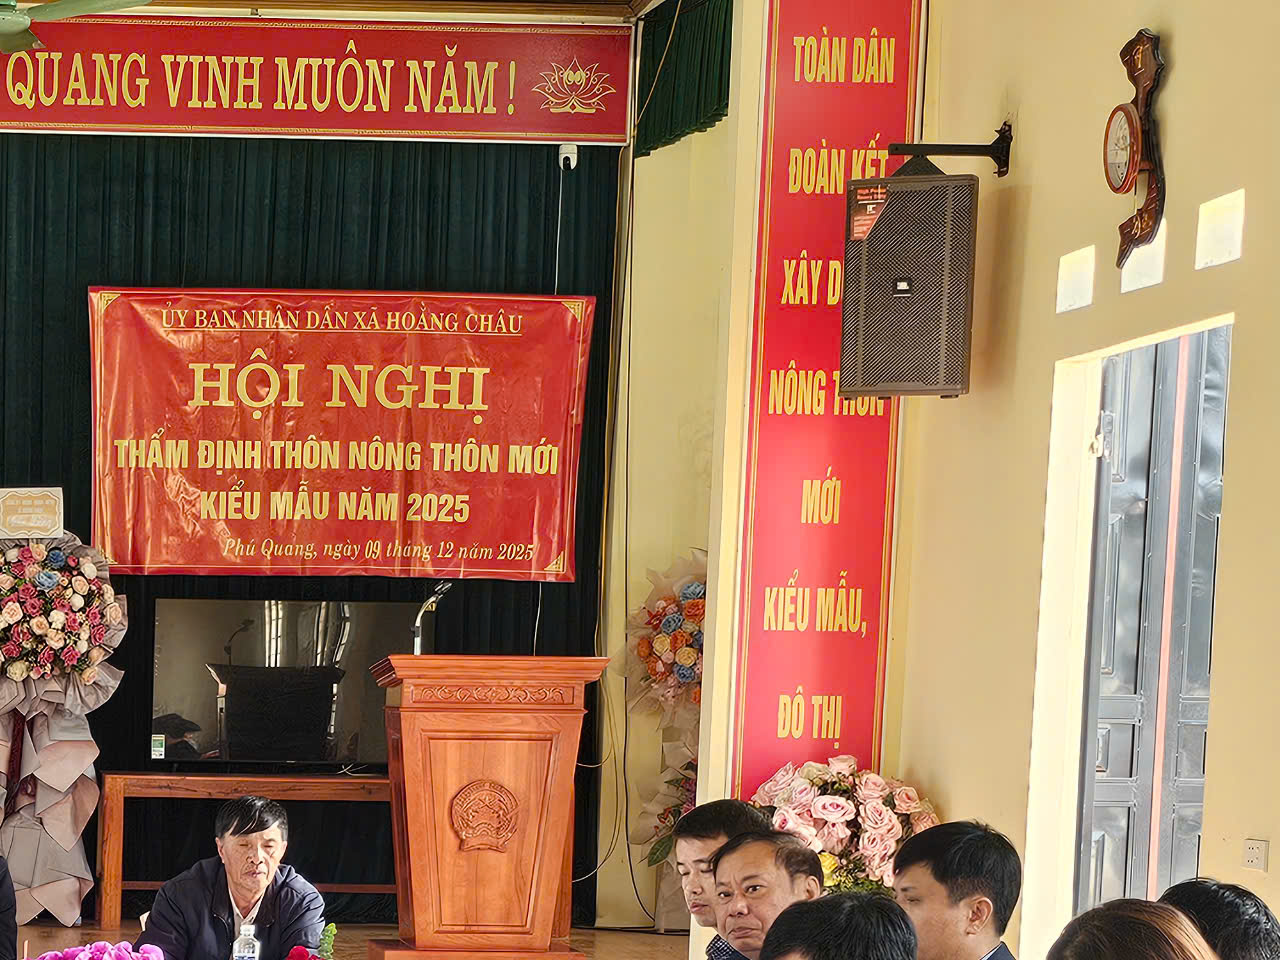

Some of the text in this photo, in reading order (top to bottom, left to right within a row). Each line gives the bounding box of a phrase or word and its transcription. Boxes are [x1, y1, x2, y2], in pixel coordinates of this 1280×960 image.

[6, 50, 150, 110] QUANG
[160, 54, 265, 110] VINH
[273, 39, 395, 113] MUÔN
[404, 44, 499, 115] NĂM
[793, 26, 896, 84] TOÀN DÂN
[788, 139, 846, 194] ĐOÀN
[781, 250, 823, 305] XÂY
[161, 301, 523, 334] ỦY BAN NHÂN DÂN XÃ HOẰNG CHÂU
[188, 347, 491, 425] HỘI NGHỊ
[768, 360, 826, 416] NÔNG
[114, 427, 559, 475] THẨM ĐỊNH THÔN NÔNG THÔN MỚI
[200, 479, 470, 523] KIỂU MẪU NĂM 2025
[801, 466, 842, 524] MỚI
[222, 538, 535, 562] Phú Quang, ngày 09 tháng 12 năm 2025
[763, 568, 867, 638] KIỂU MẪU,
[777, 685, 843, 749] ĐÔ THỊ
